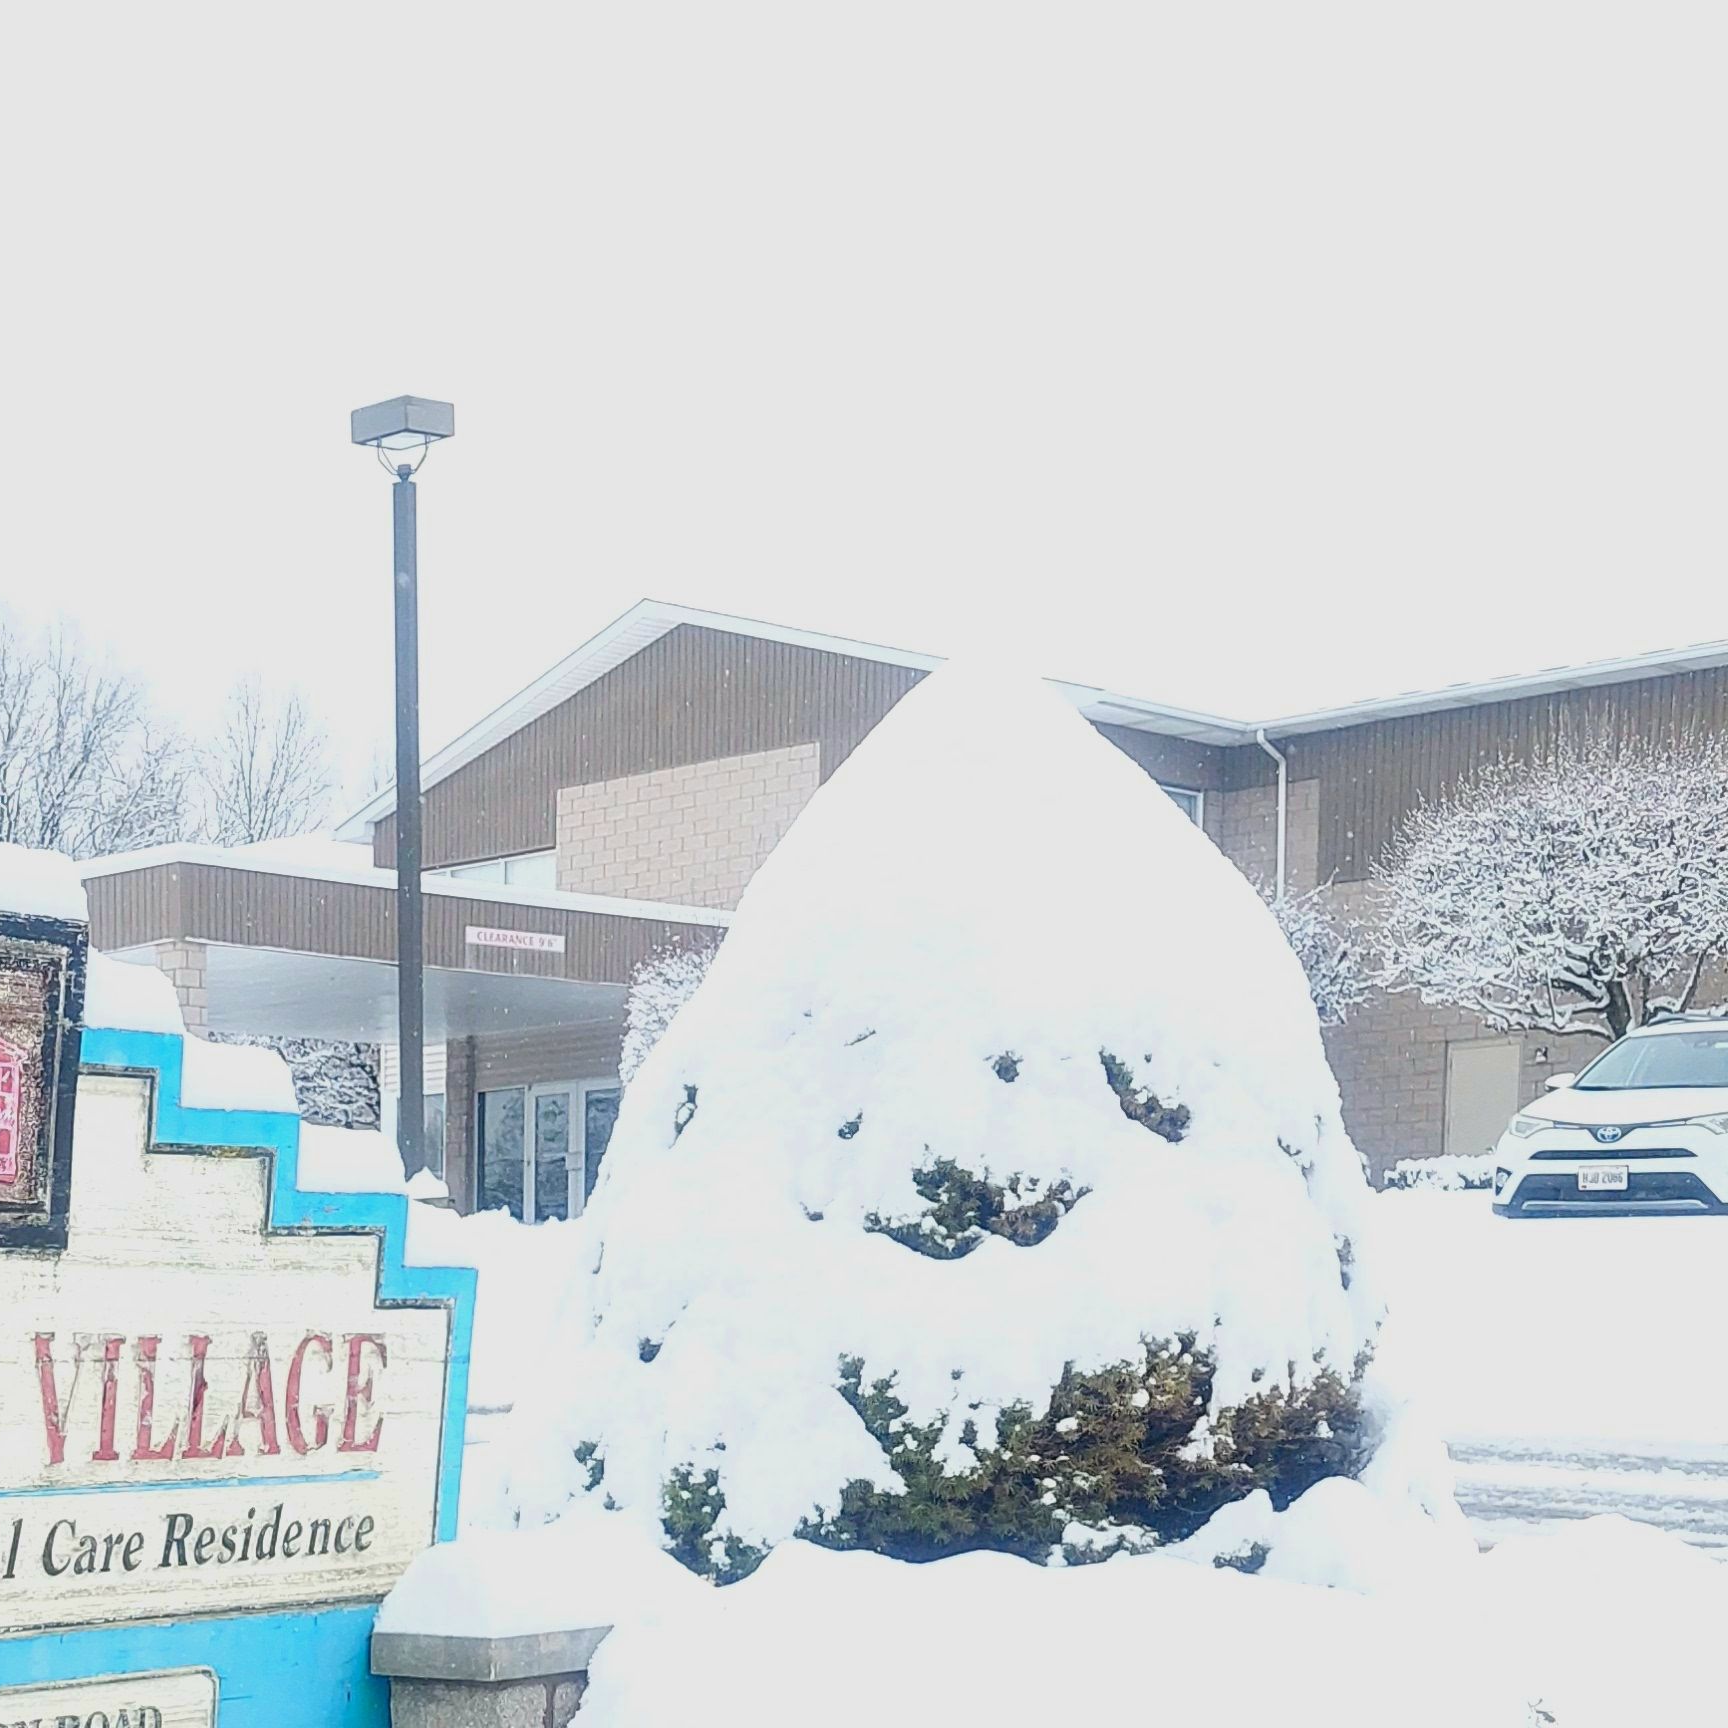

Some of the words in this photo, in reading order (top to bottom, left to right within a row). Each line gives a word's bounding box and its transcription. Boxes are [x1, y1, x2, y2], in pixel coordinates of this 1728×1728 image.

[477, 931, 534, 946] CLEARANCE
[33, 1331, 390, 1466] VILLAGE
[41, 1518, 145, 1576] Care
[158, 1503, 375, 1568] Residence
